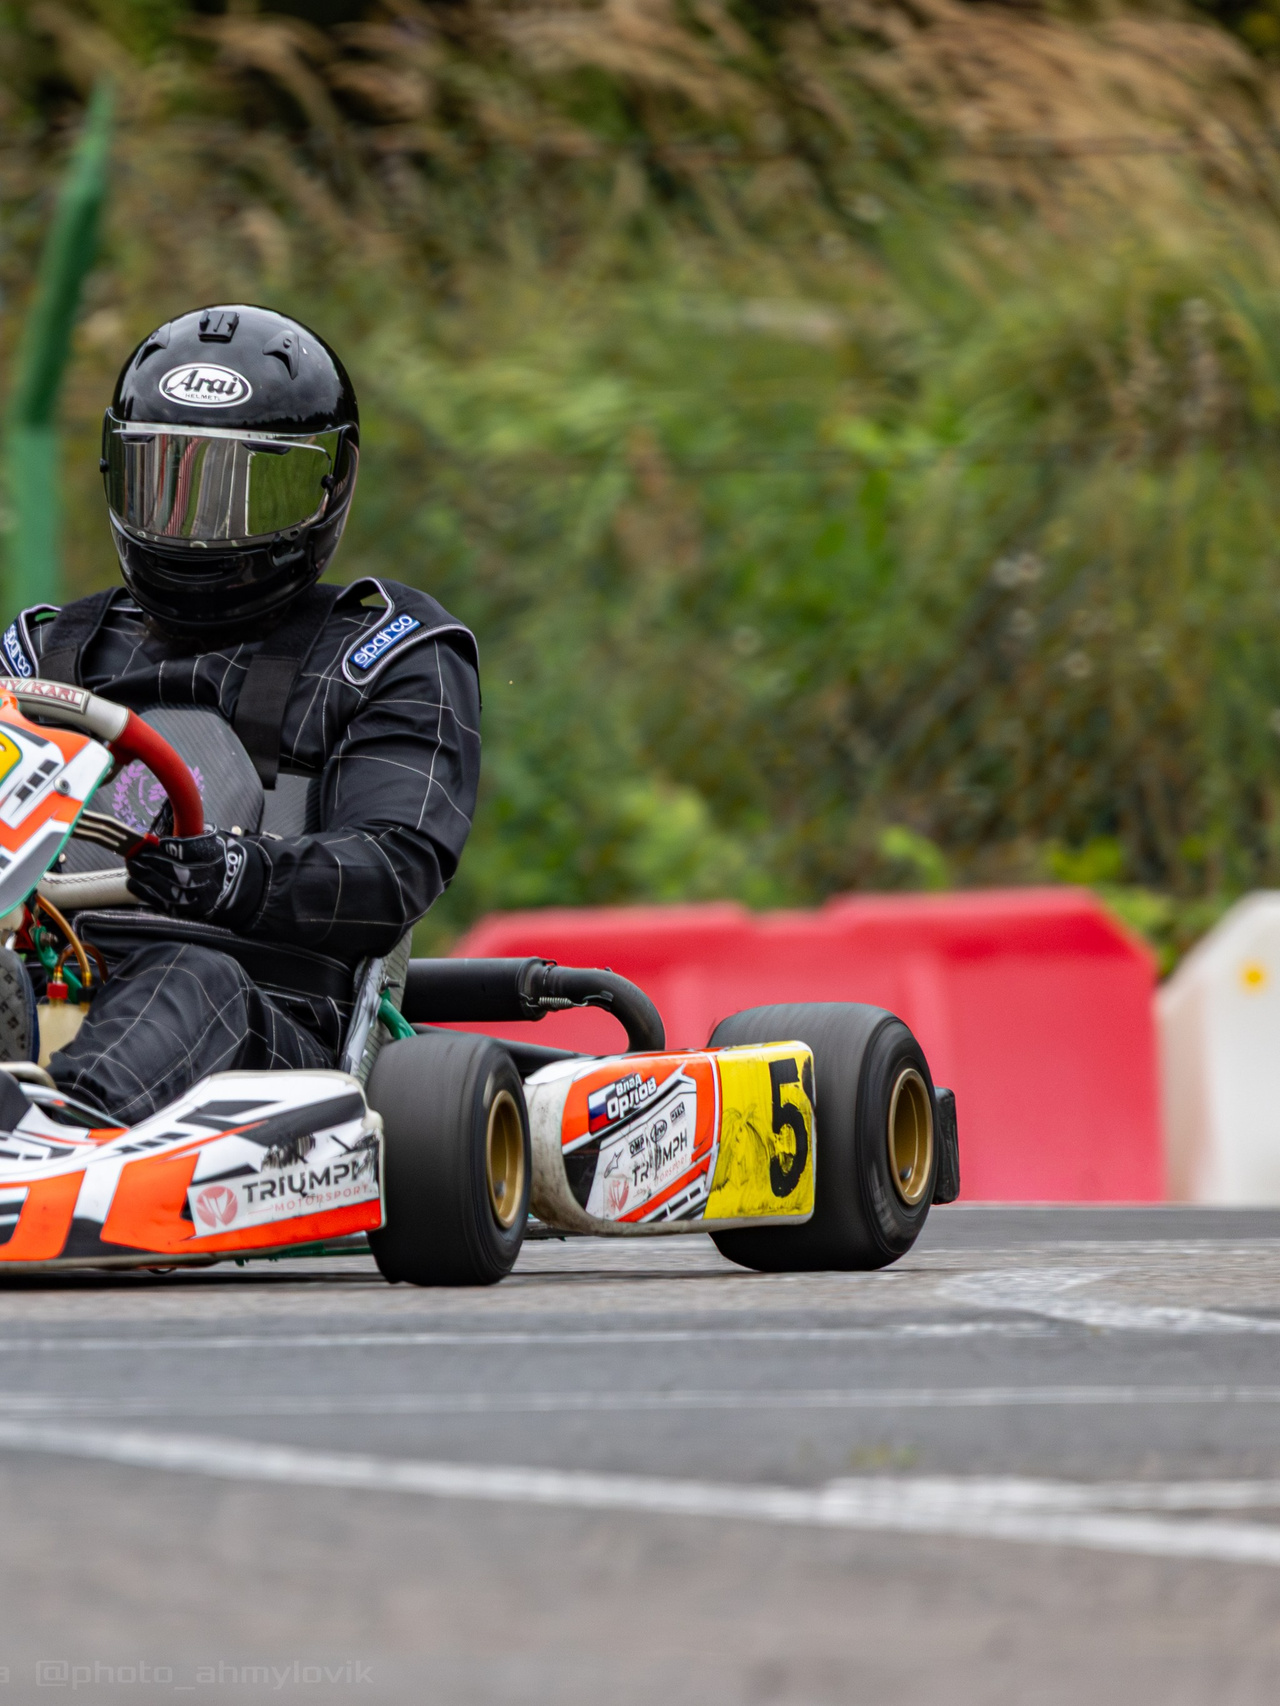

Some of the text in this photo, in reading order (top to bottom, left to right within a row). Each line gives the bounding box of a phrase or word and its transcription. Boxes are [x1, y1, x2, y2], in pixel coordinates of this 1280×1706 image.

[165, 369, 239, 396] Arai
[353, 615, 414, 664] sparco
[769, 1058, 808, 1198] 5
[629, 1135, 645, 1155] OMP
[273, 1183, 369, 1212] MOTORSPORT
